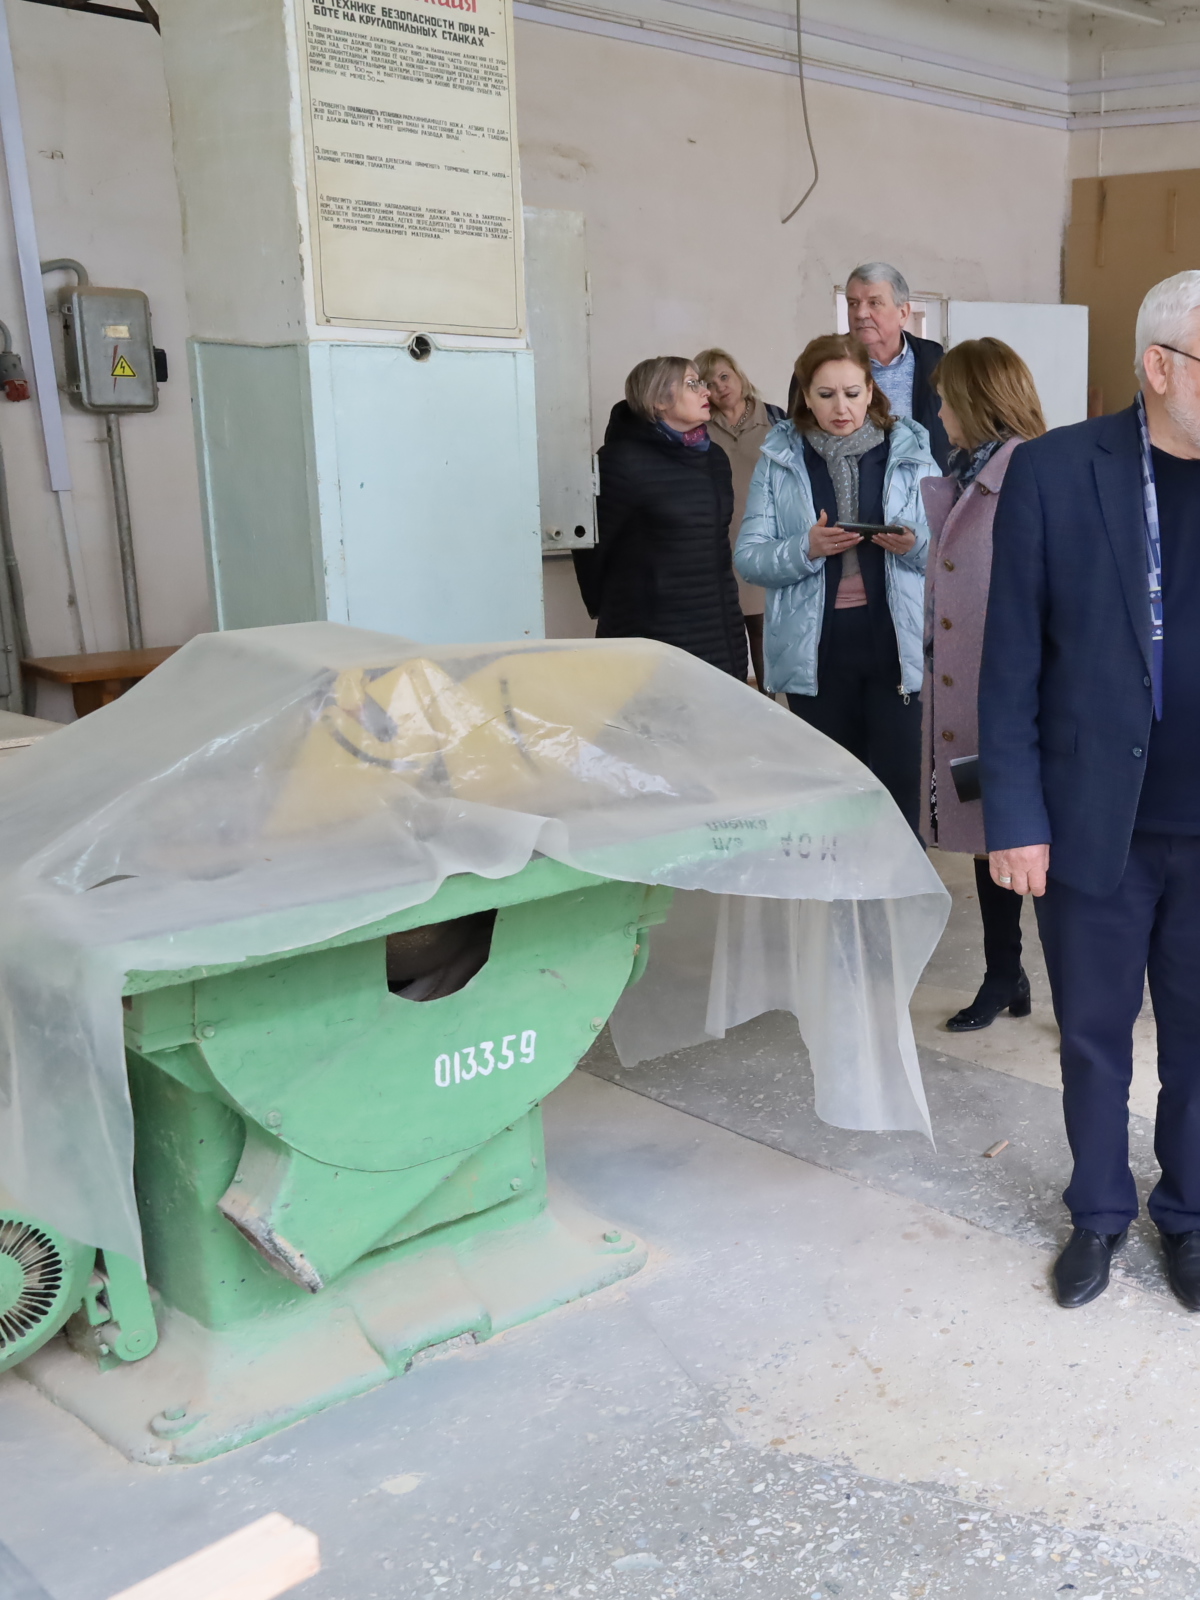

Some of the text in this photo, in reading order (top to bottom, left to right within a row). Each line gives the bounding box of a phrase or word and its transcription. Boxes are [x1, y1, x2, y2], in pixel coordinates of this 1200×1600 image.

[313, 5, 485, 48] БОТЕ НА КРУГЛОПИЛЬНЫХ СТАНКАХ
[332, 0, 376, 15] ТЕХНИКЕ
[381, 6, 455, 30] БЕЗОПАСНОСТИ
[458, 22, 476, 34] ПРИ
[434, 1030, 536, 1087] 013359
